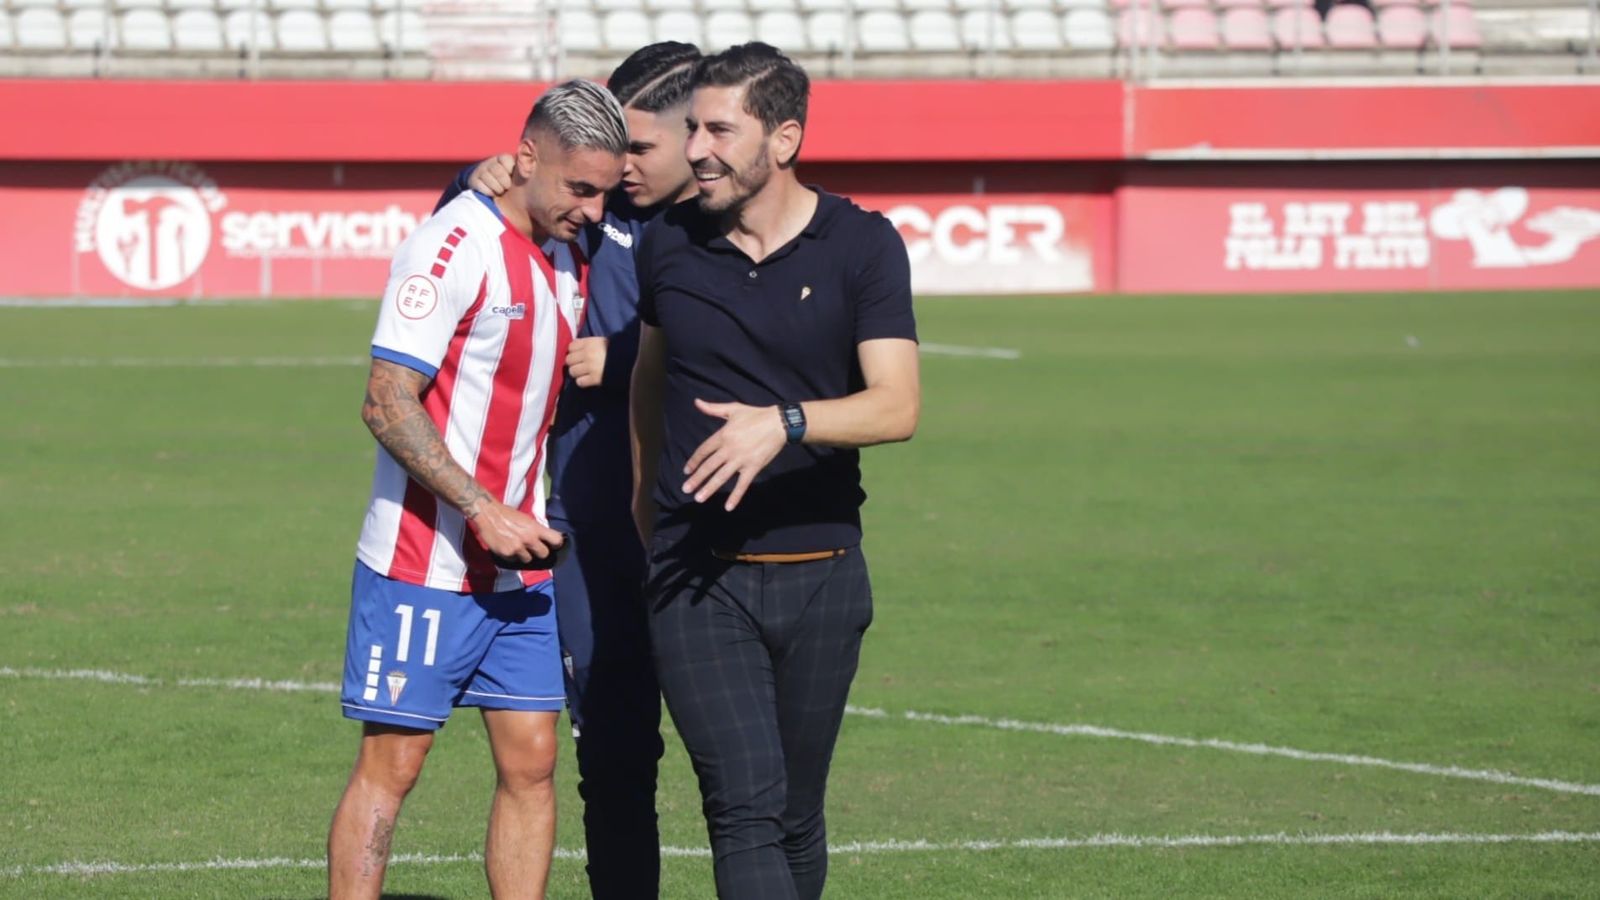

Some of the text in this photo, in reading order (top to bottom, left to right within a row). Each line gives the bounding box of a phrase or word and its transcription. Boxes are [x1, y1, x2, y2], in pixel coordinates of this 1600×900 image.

[884, 204, 1065, 265] CCER
[491, 304, 524, 317] capelli
[394, 604, 441, 666] 11
